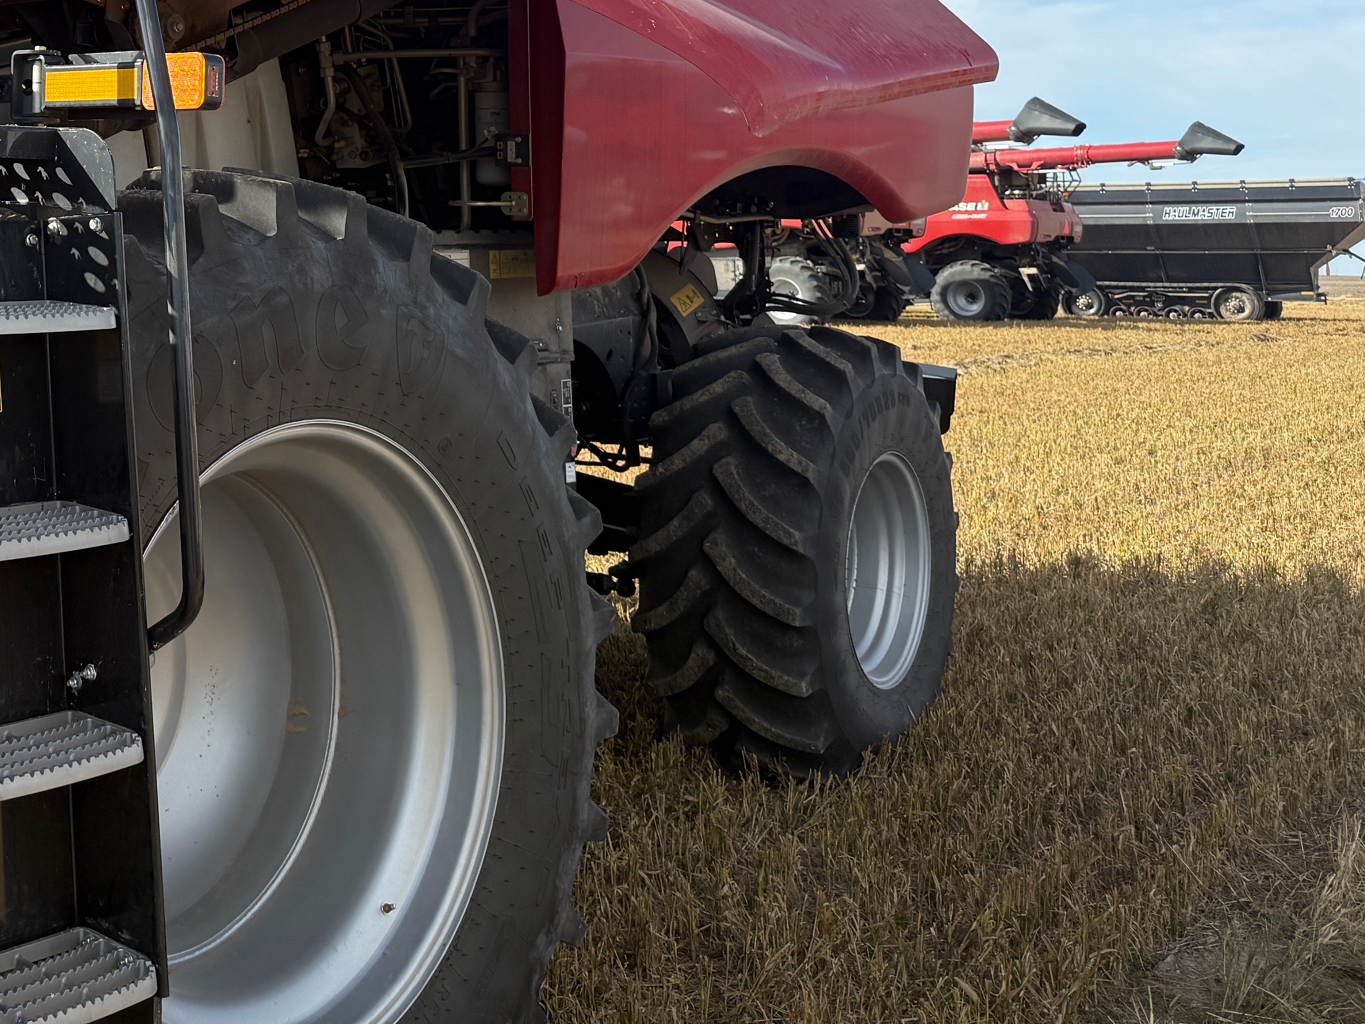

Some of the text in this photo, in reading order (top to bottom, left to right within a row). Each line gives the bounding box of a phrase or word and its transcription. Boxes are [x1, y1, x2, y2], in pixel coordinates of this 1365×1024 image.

[947, 201, 976, 211] ASE
[1162, 207, 1236, 220] HAULMASTER
[1329, 207, 1354, 218] 1700
